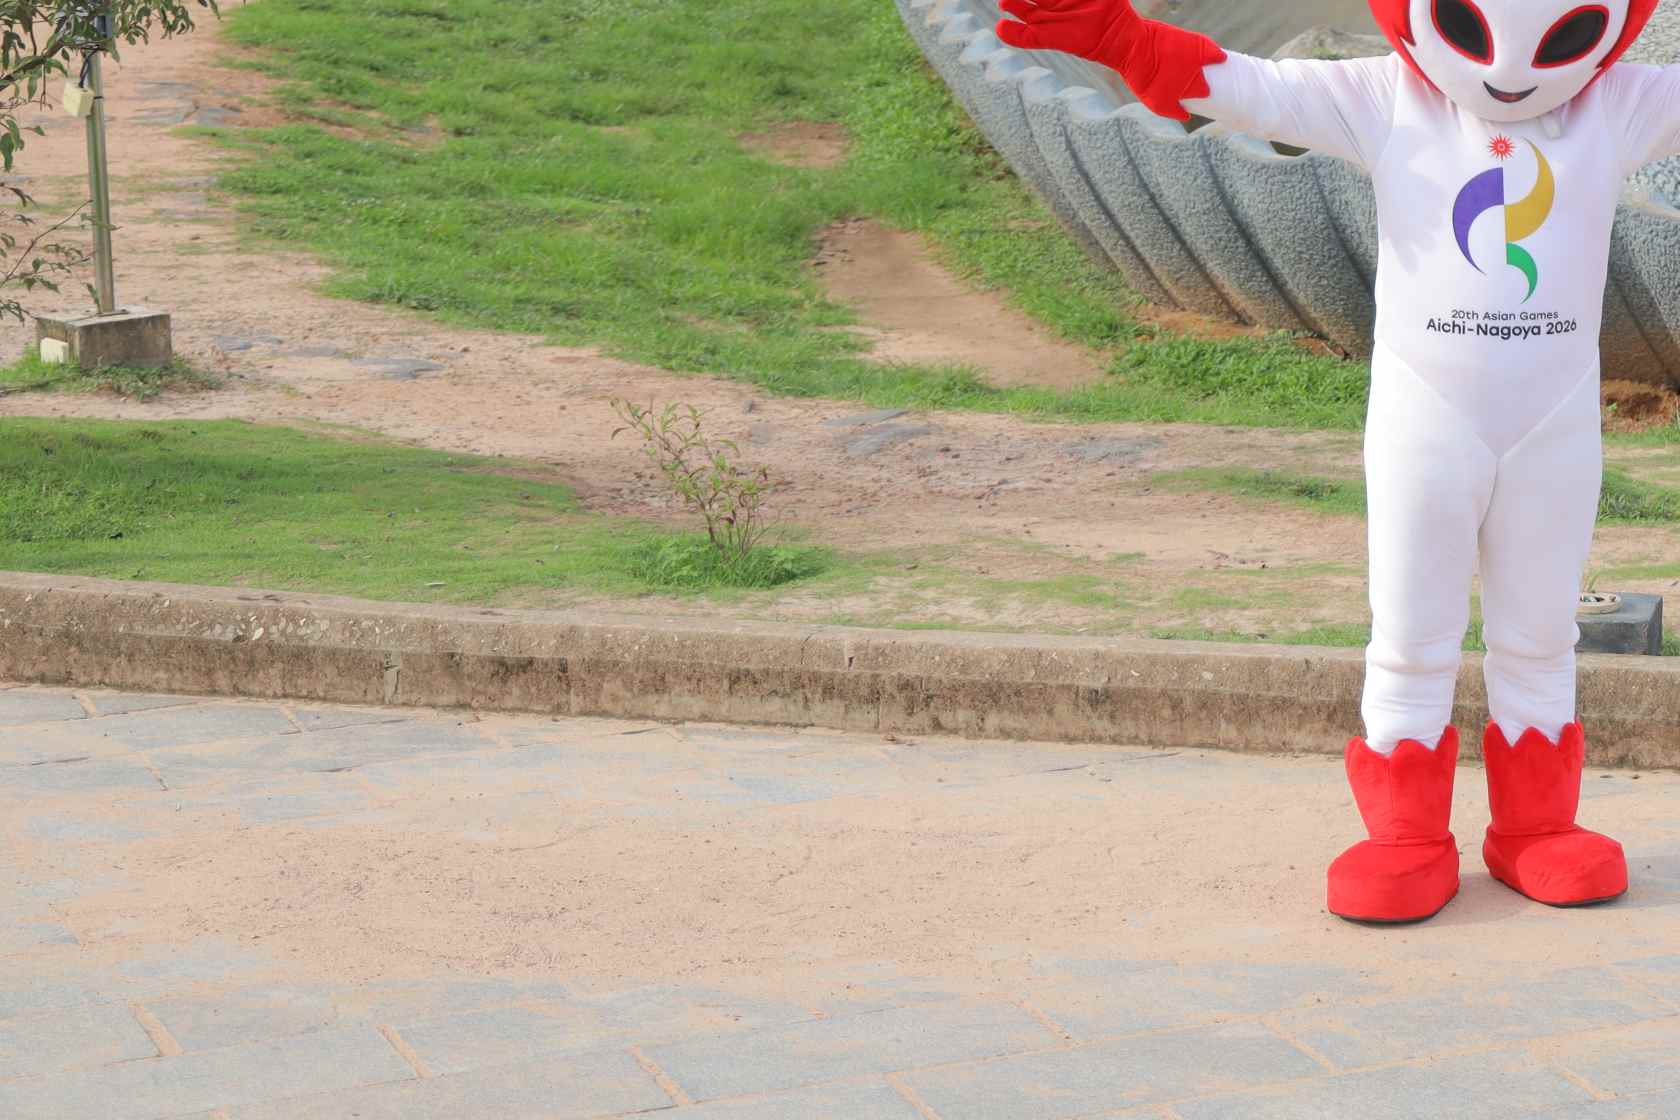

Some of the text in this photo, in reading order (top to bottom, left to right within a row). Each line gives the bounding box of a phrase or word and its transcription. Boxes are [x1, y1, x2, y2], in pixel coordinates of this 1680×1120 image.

[1451, 310, 1559, 321] 20th Asian Games
[1426, 318, 1577, 340] Aichi-Nagoya 2026
